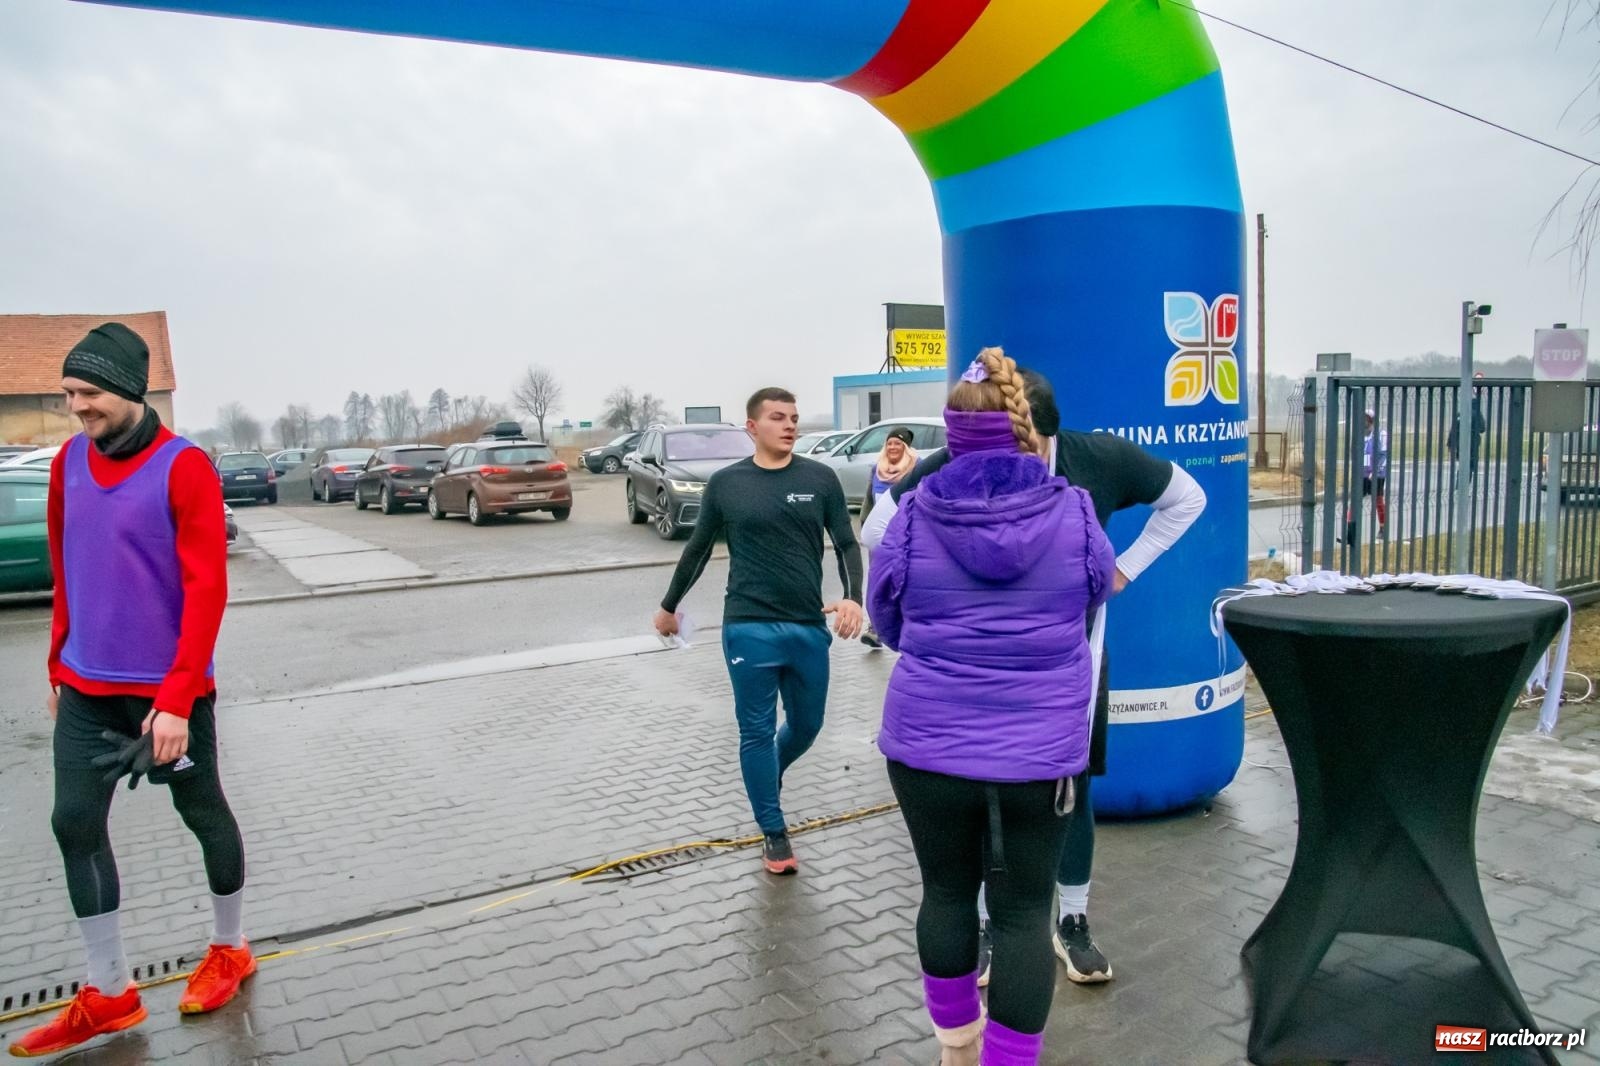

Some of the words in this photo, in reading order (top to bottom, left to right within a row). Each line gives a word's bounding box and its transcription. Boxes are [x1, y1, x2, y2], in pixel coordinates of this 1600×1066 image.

[895, 342, 917, 355] 575
[920, 342, 942, 355] 792
[1541, 349, 1581, 361] STOP
[1092, 425, 1169, 445] MINA
[1185, 456, 1216, 468] poznaj
